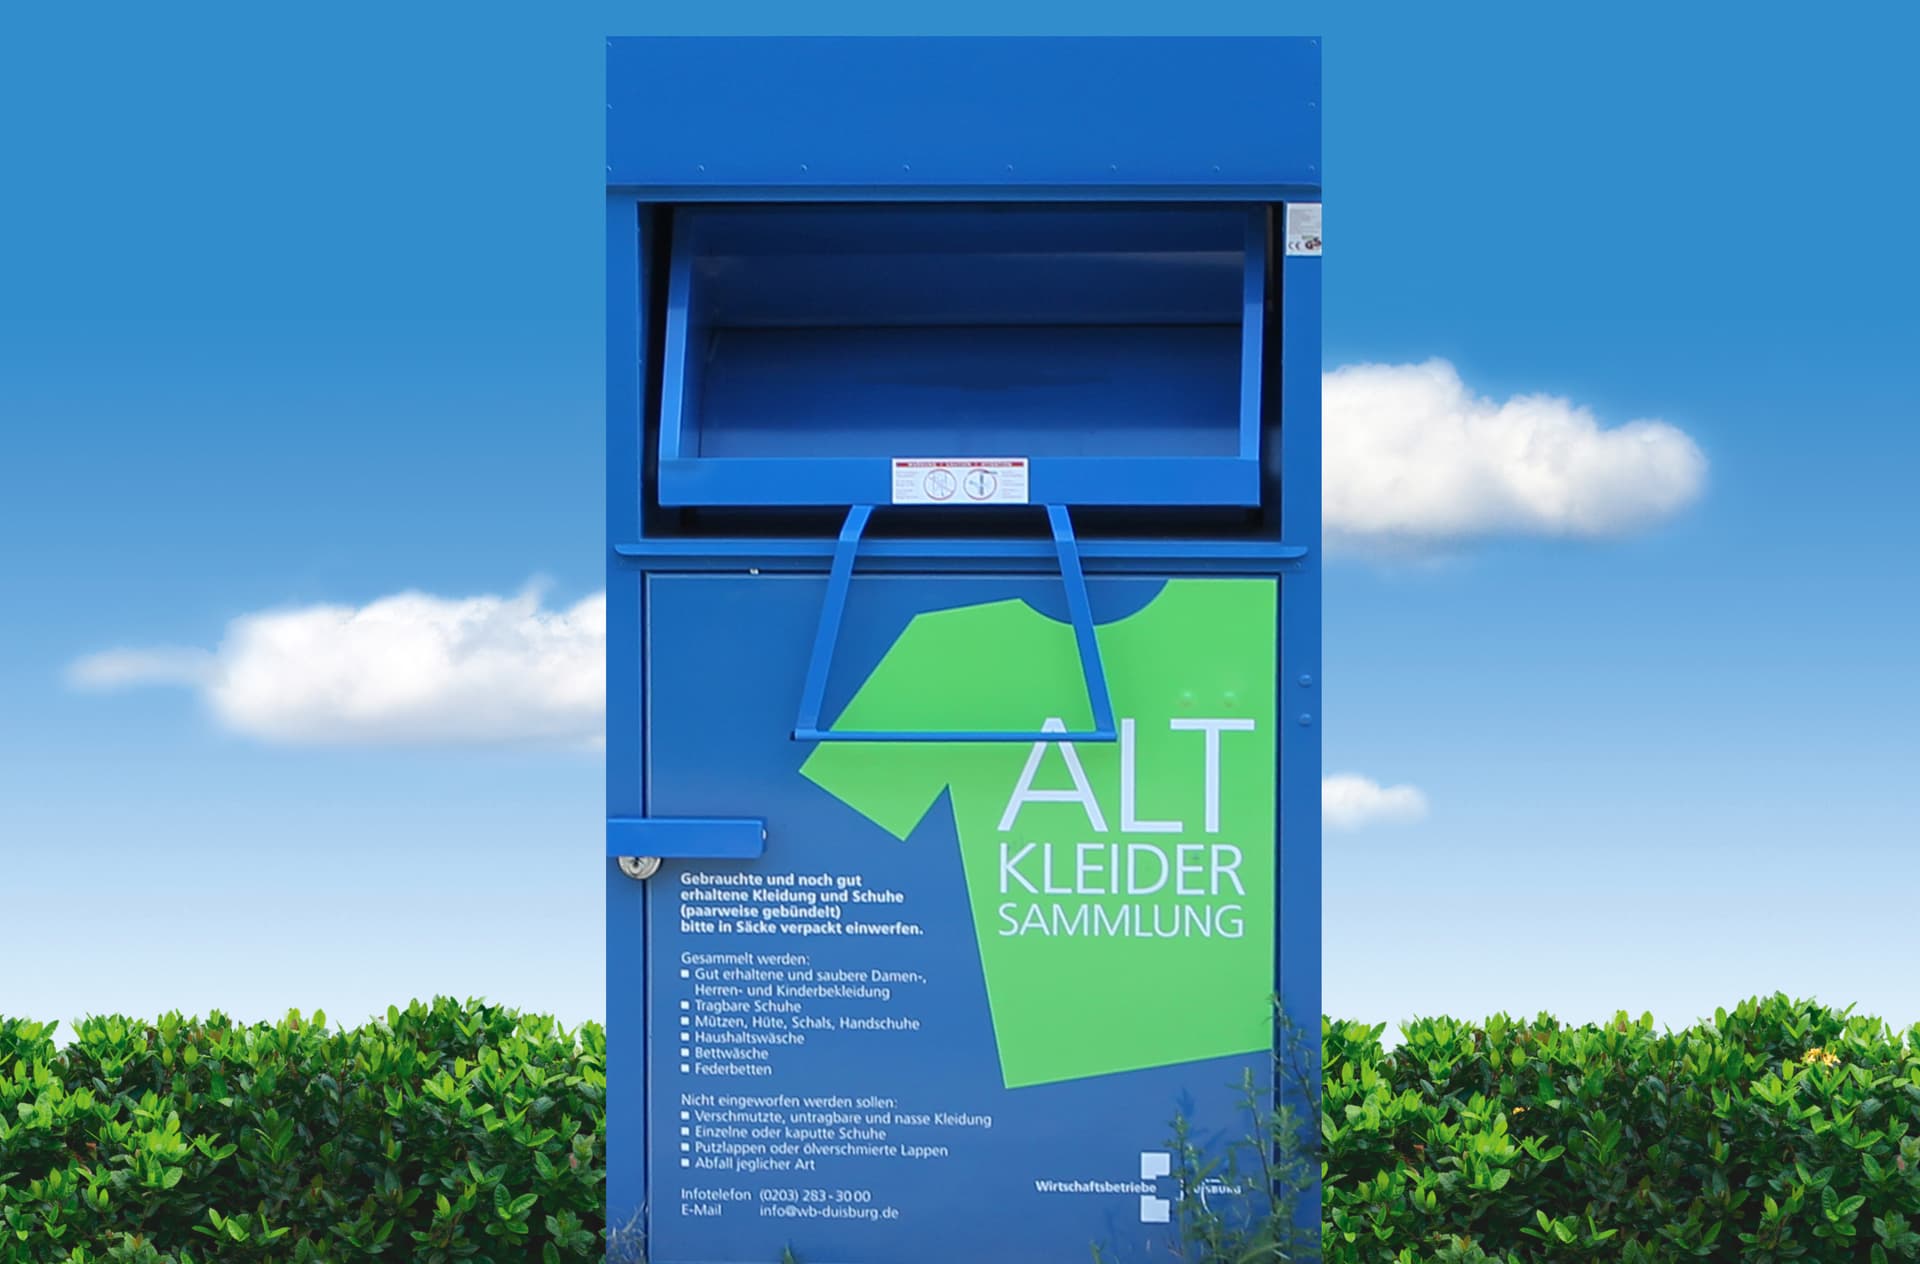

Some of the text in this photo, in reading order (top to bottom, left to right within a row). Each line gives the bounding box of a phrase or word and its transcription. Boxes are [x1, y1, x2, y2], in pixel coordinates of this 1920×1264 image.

[997, 717, 1255, 832] ALT
[1000, 842, 1246, 895] KLEIDER
[681, 872, 862, 890] Gebrauchte und noch gut
[681, 888, 904, 906] erhaltene Kleidung und Schuhe
[680, 904, 840, 920] (paarweise gebündelt)
[681, 920, 923, 936] bitte in Säcke verpackt einwerfen.
[998, 903, 1244, 938] SAMMLUNG
[681, 952, 809, 965] Gesammelt werden:
[695, 968, 719, 980] Gut
[723, 968, 783, 981] erhaltene
[788, 969, 813, 981] und
[817, 969, 868, 982] saubere
[695, 984, 890, 1001] Herren- und Kinderbekleidung
[695, 1000, 801, 1014] Tragbare Schuhe
[695, 1015, 920, 1030] Mützen, Hüte, Schals, Handschuhe
[695, 1031, 804, 1044] Haushaltswäsche
[695, 1047, 768, 1060] Bettwäsche
[695, 1063, 772, 1075] Federbetten
[681, 1093, 897, 1109] Nicht eingeworfen werden sollen:
[695, 1110, 992, 1128] Verschmutzte, untragbare und nasse Kleidung
[696, 1126, 886, 1141] Einzelne oder kaputte Schuhe
[696, 1142, 948, 1158] Putzlappen oder ölverschmierte Lappen
[695, 1157, 815, 1172] Abfall jeglicher Art
[1035, 1180, 1156, 1193] Wirtschaftsbetriebe
[681, 1189, 751, 1200] Infotelefon
[760, 1189, 799, 1202] (0203)
[682, 1204, 899, 1221] E-Mail info@wb-duisburg.de
